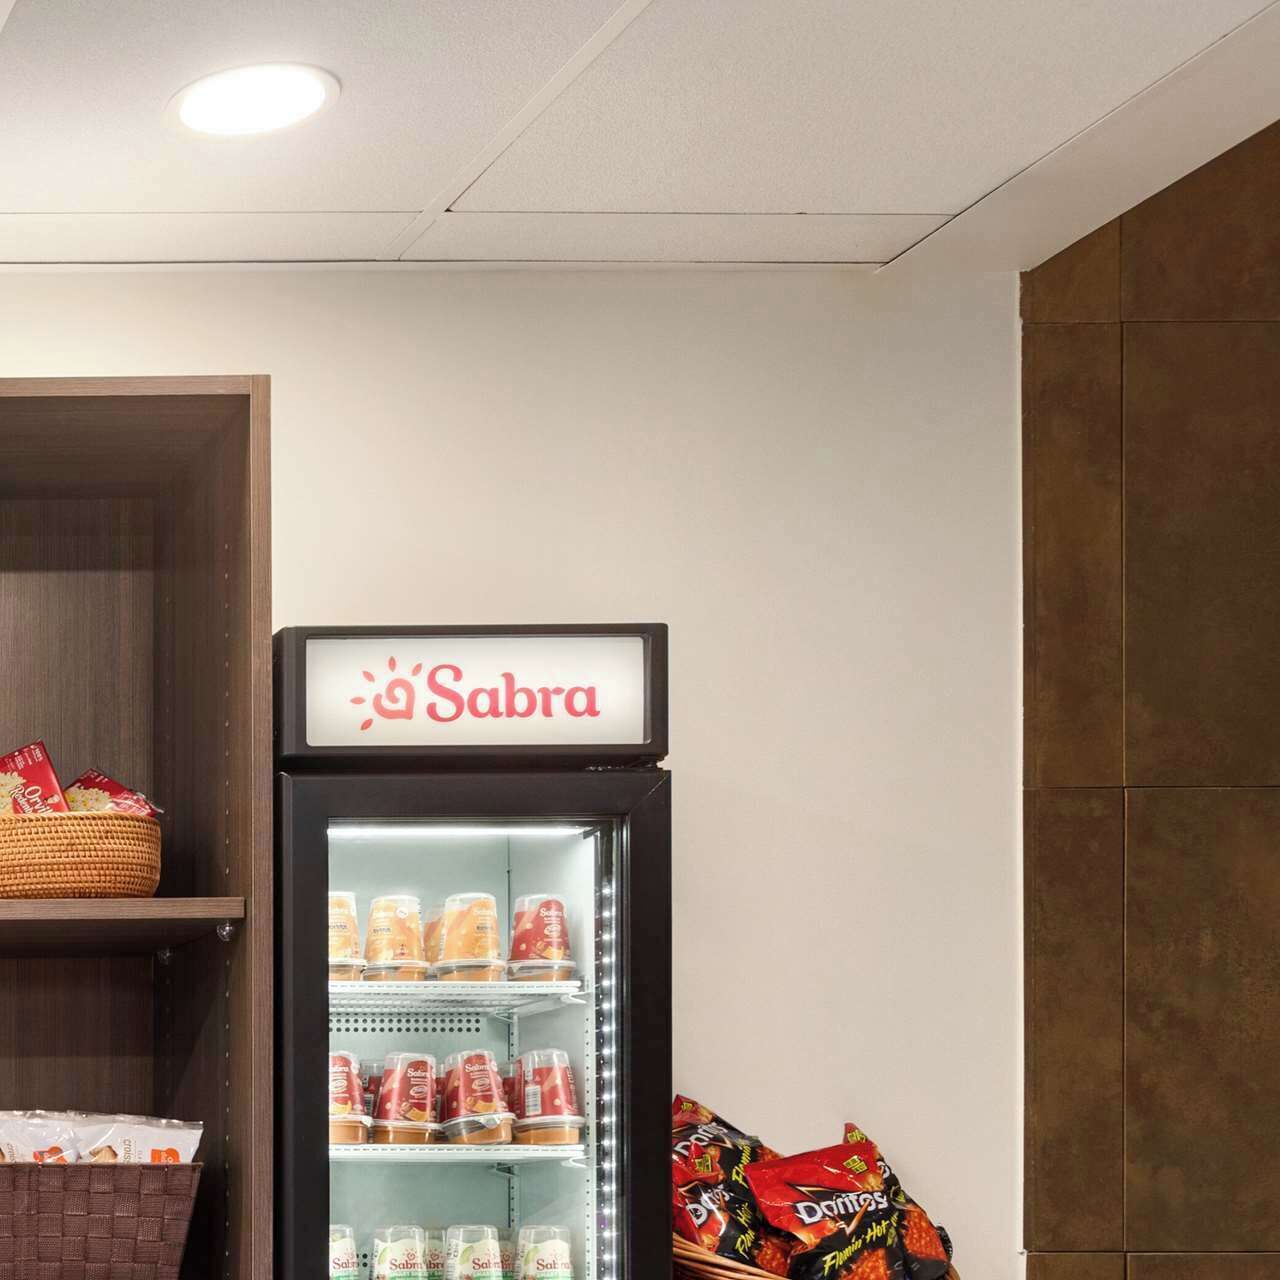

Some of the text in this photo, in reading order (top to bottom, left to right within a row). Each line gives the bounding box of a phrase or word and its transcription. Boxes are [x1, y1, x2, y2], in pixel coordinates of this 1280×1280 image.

[426, 664, 600, 722] Sabra
[796, 1191, 890, 1225] Doritos
[822, 1219, 891, 1277] Flamin' Hot
[332, 1257, 359, 1271] Sabra
[389, 1258, 423, 1272] Sabra
[536, 1257, 571, 1271] Sabra
